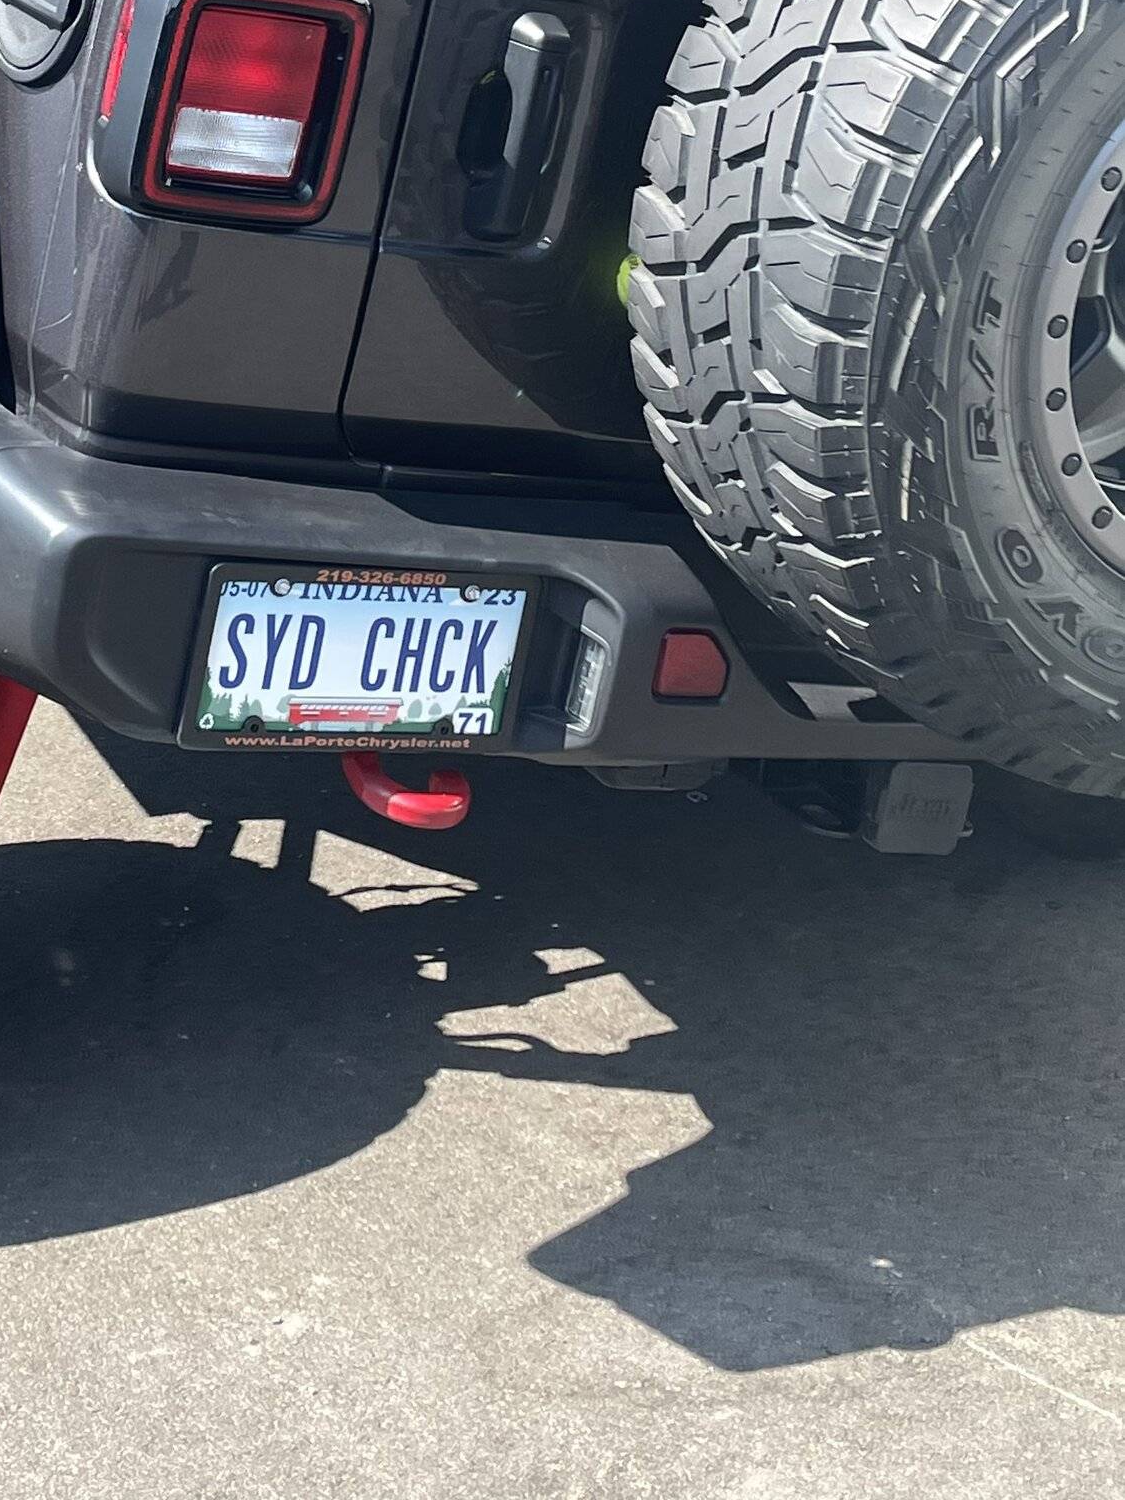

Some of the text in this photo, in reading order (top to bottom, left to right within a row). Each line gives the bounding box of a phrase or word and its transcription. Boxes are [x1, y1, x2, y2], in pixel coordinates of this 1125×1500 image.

[968, 270, 1003, 463] R/T
[315, 568, 447, 585] 219-326-6850
[298, 582, 444, 604] INDIANA
[483, 589, 517, 606] 23
[219, 612, 498, 694] SYD CHCK
[457, 712, 488, 734] 71
[224, 735, 471, 749] www.LaPorteChrysler.net
